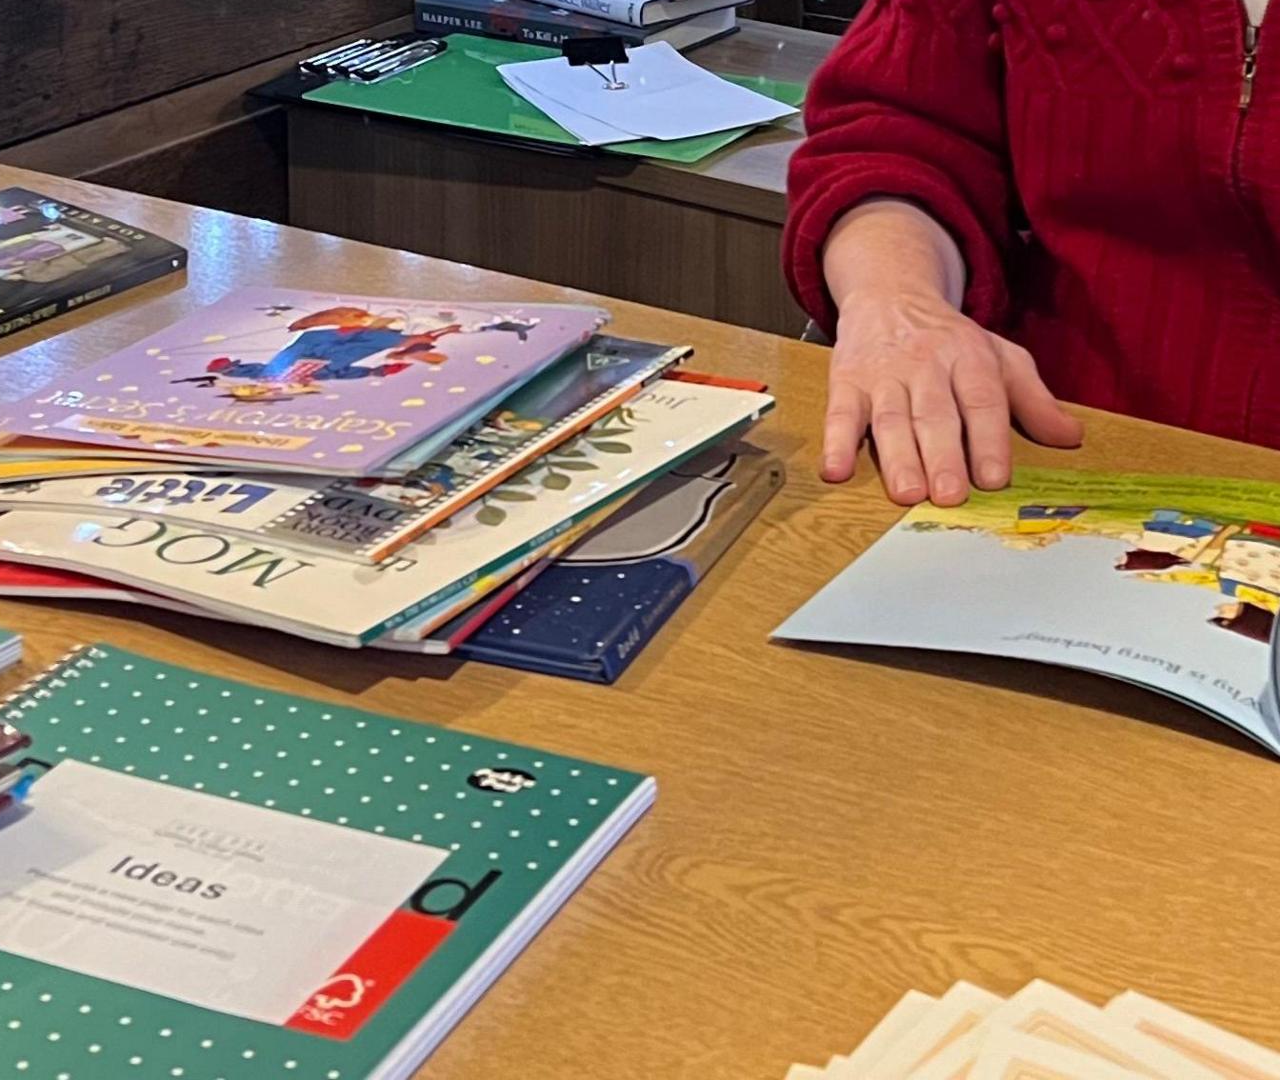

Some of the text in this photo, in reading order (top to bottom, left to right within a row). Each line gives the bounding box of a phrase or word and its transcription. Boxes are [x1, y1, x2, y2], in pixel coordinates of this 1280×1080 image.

[422, 12, 483, 30] HARPER LEE
[522, 28, 534, 38] To
[535, 31, 552, 42] Kill
[35, 390, 413, 442] Scarecrow's Secret
[95, 477, 278, 516] Little
[322, 497, 405, 521] DVD
[292, 519, 363, 543] STORY
[307, 509, 381, 537] BOOK
[92, 517, 317, 590] MOG
[109, 855, 228, 901] Ideas
